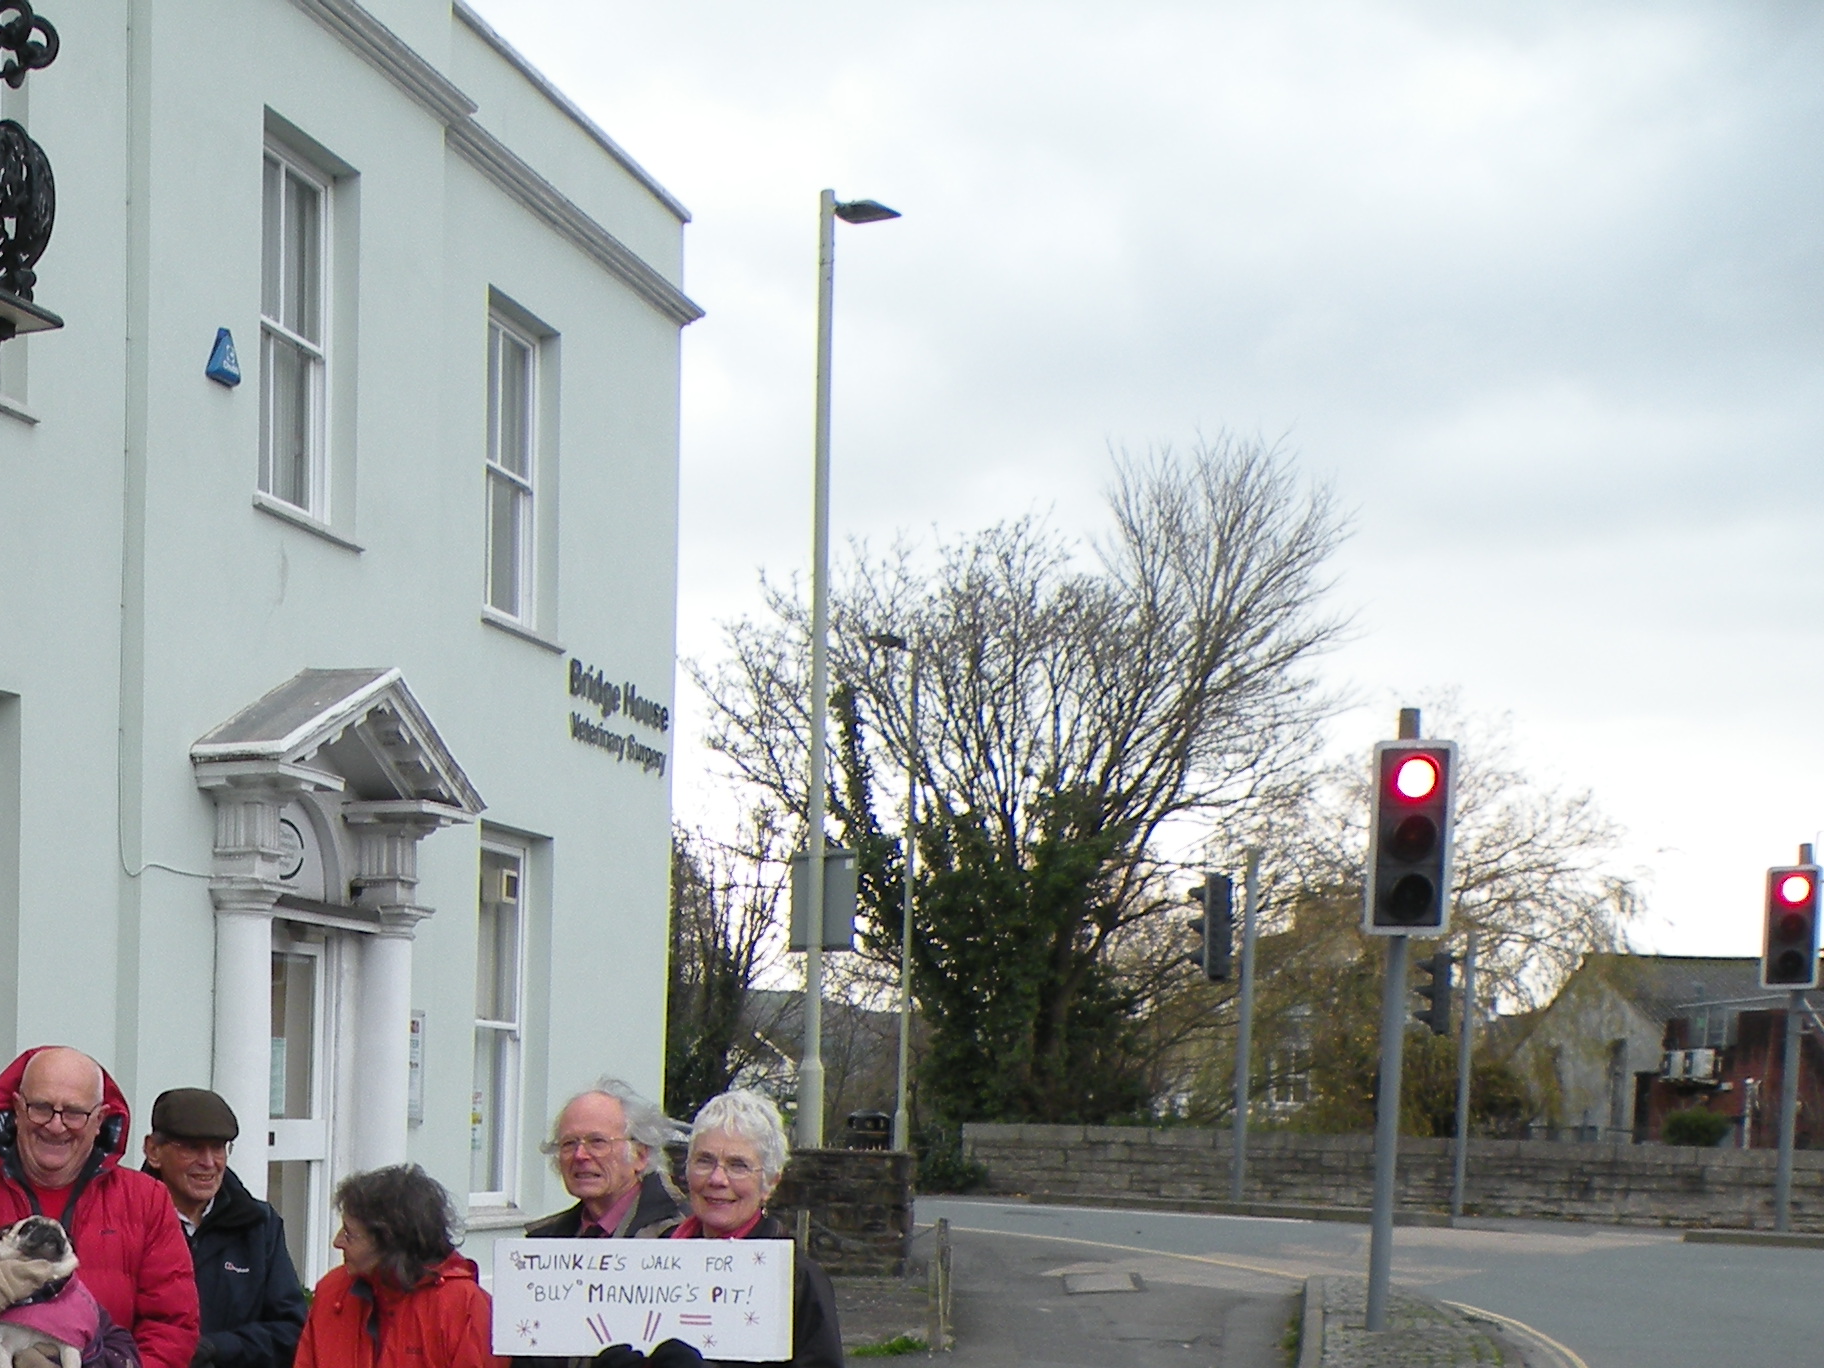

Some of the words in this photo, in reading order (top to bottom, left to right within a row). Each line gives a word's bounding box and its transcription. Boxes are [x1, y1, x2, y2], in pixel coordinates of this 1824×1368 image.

[568, 657, 622, 719] Bridge
[622, 681, 669, 733] House
[568, 710, 627, 763] Veterinary
[625, 733, 668, 779] Surgery
[523, 1252, 628, 1272] TWINKLE'S
[641, 1255, 683, 1271] WALK
[705, 1255, 734, 1273] FOR
[587, 1282, 700, 1304] MANNING'S
[710, 1285, 754, 1305] PIT!
